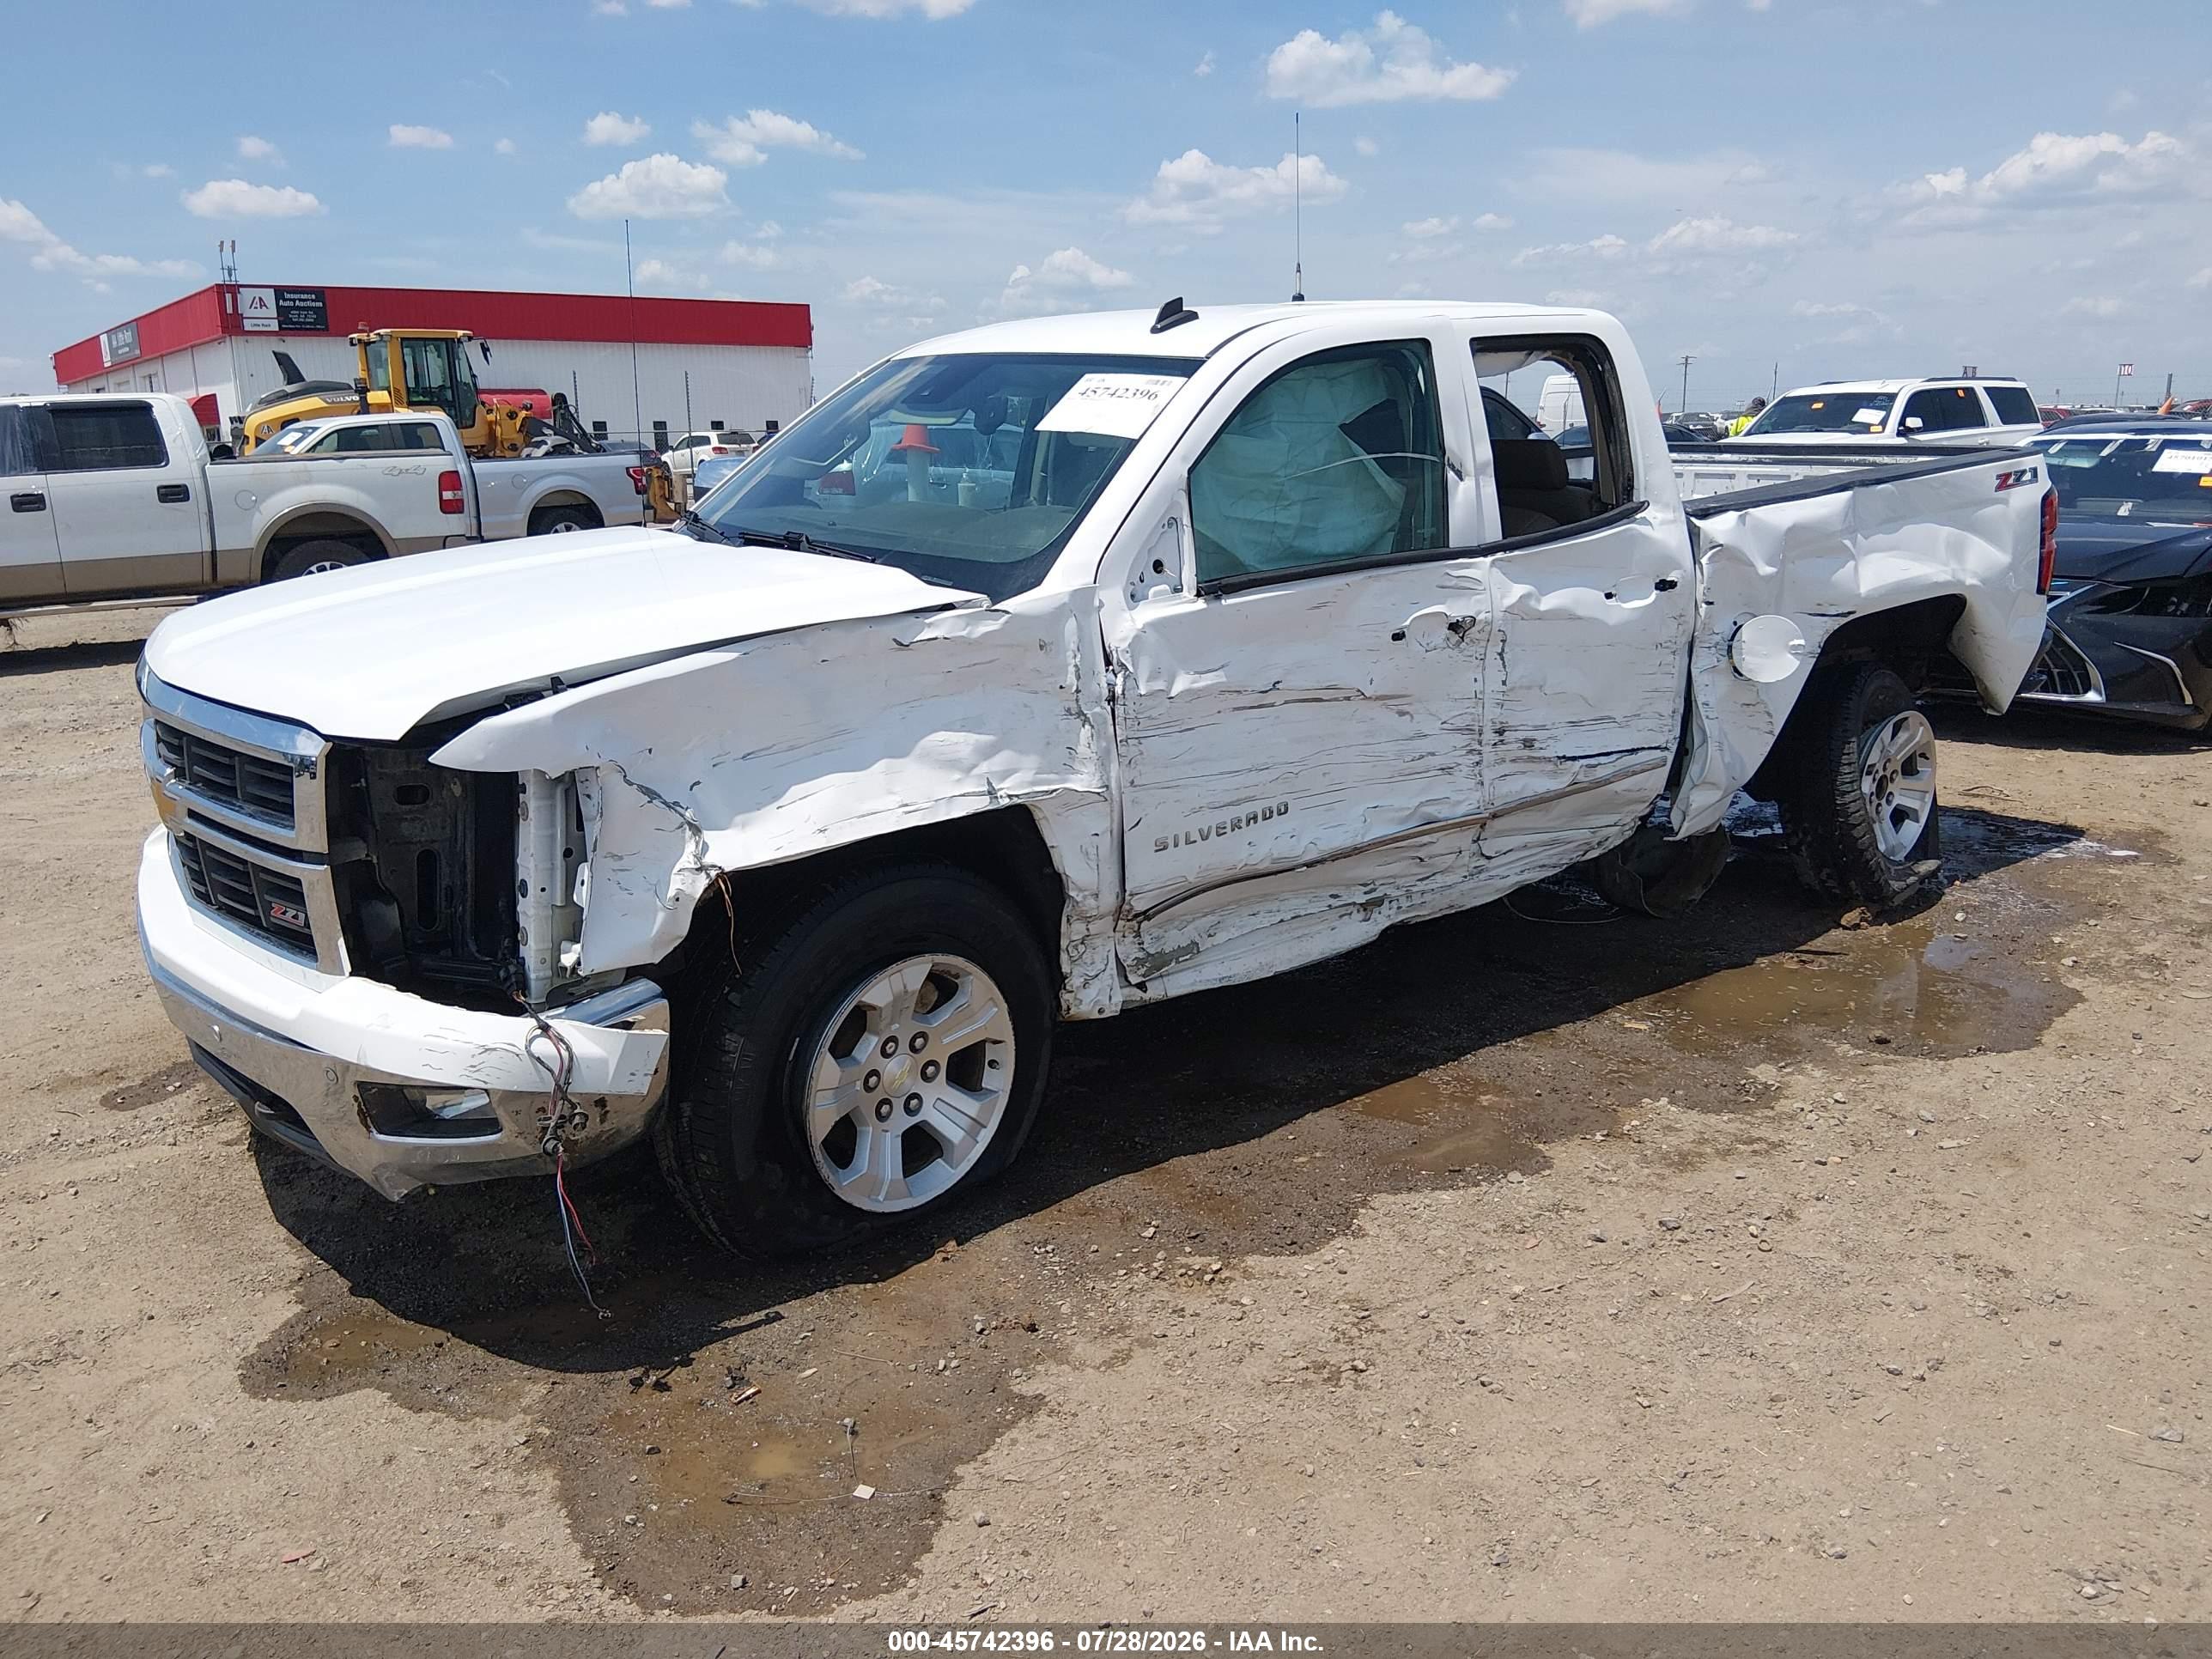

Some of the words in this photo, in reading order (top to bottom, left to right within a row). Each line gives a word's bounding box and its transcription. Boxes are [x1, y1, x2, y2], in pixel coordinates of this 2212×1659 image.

[284, 291, 316, 300] Insurance
[1079, 386, 1161, 401] 45742396
[1994, 465, 2039, 493] Z71
[1153, 800, 1289, 854] SILVERADO
[270, 902, 306, 927] Z71
